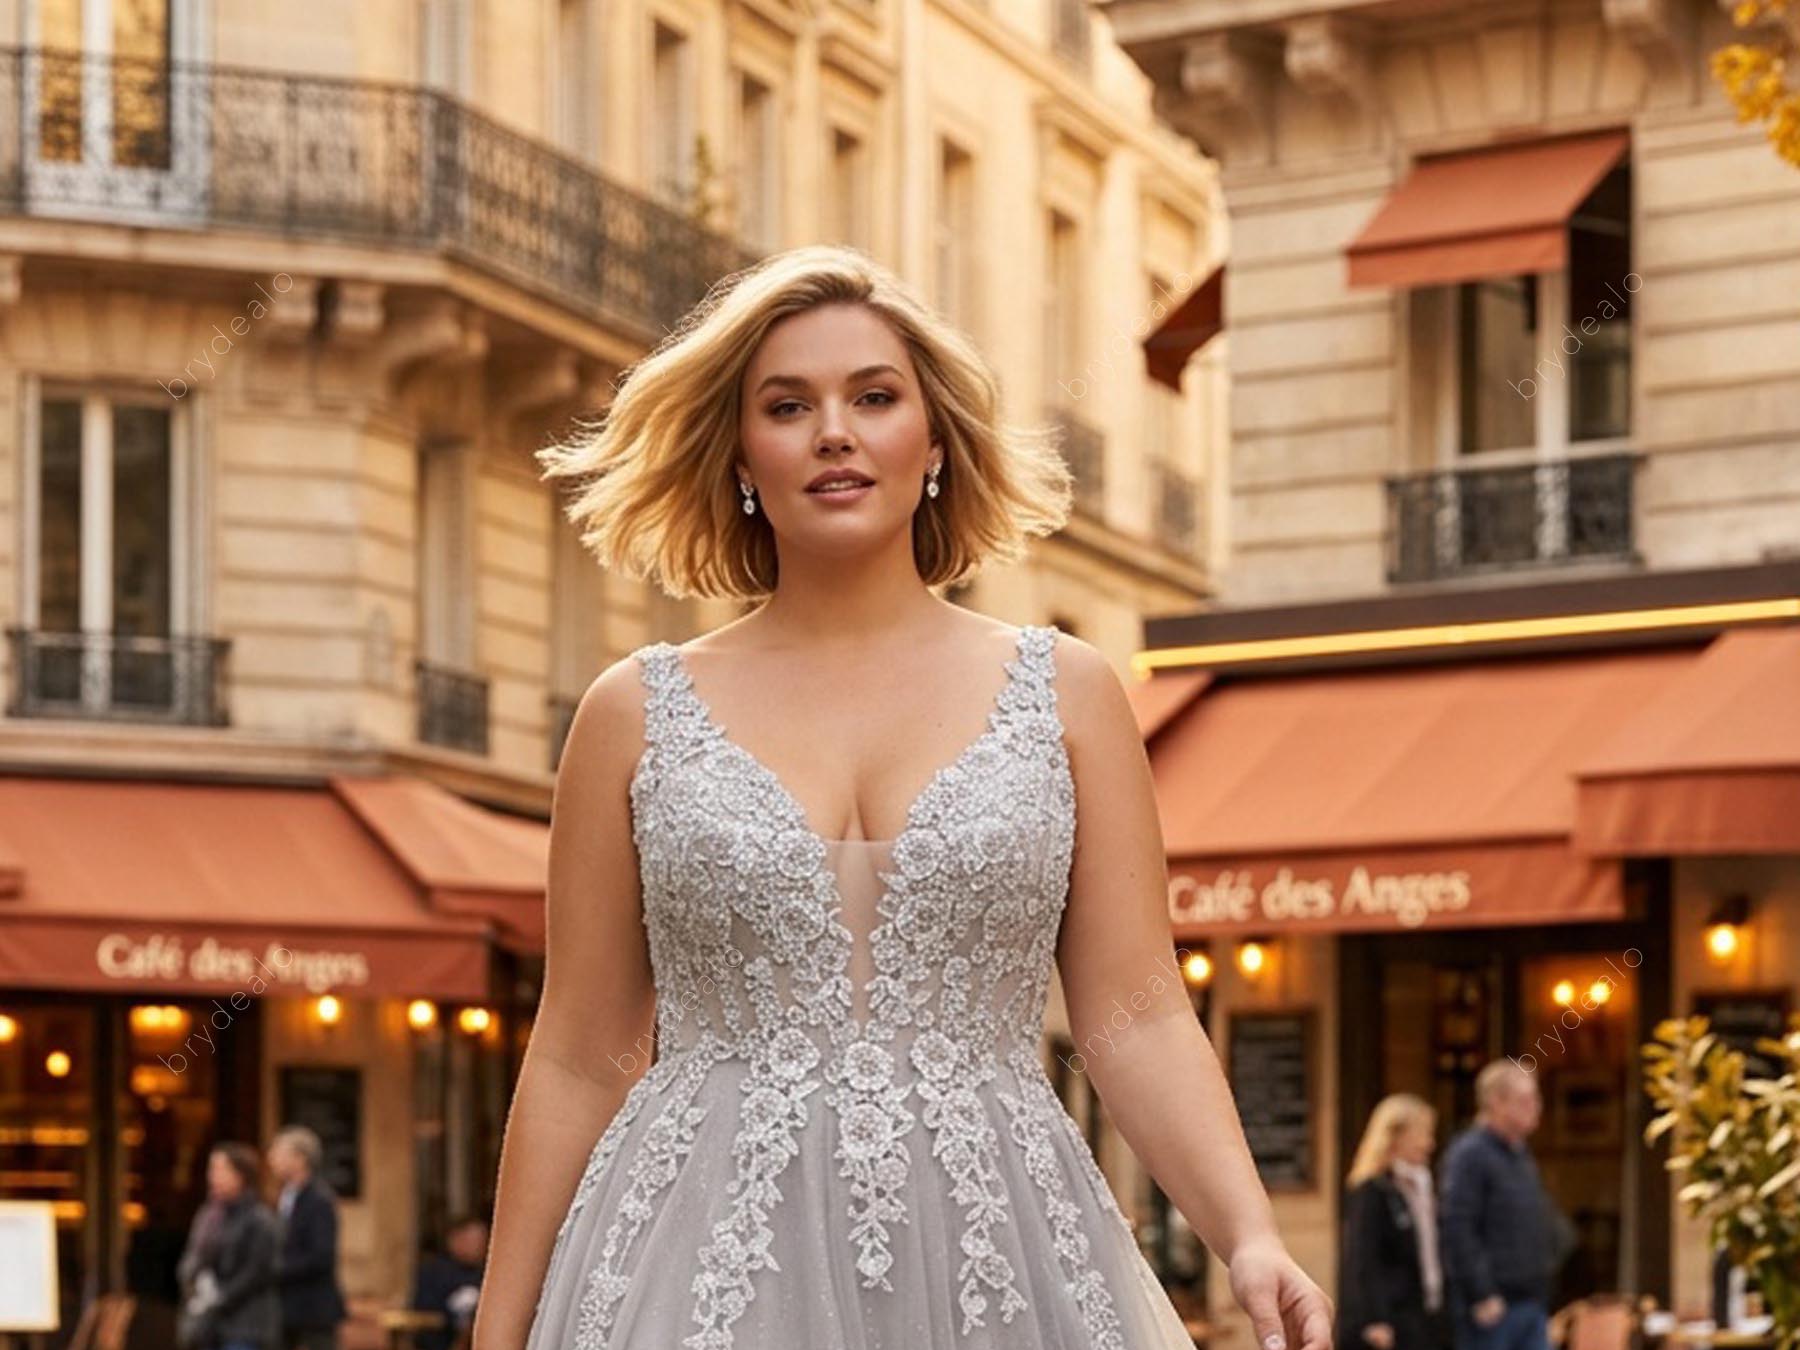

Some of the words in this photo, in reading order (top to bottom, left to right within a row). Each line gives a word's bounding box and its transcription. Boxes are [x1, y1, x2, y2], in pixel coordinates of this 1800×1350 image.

[1168, 869, 1254, 924] Café
[1261, 866, 1334, 920] des
[1341, 865, 1471, 928] Anges
[97, 933, 184, 981] Café
[190, 937, 252, 983] des
[260, 940, 370, 994] Anges
